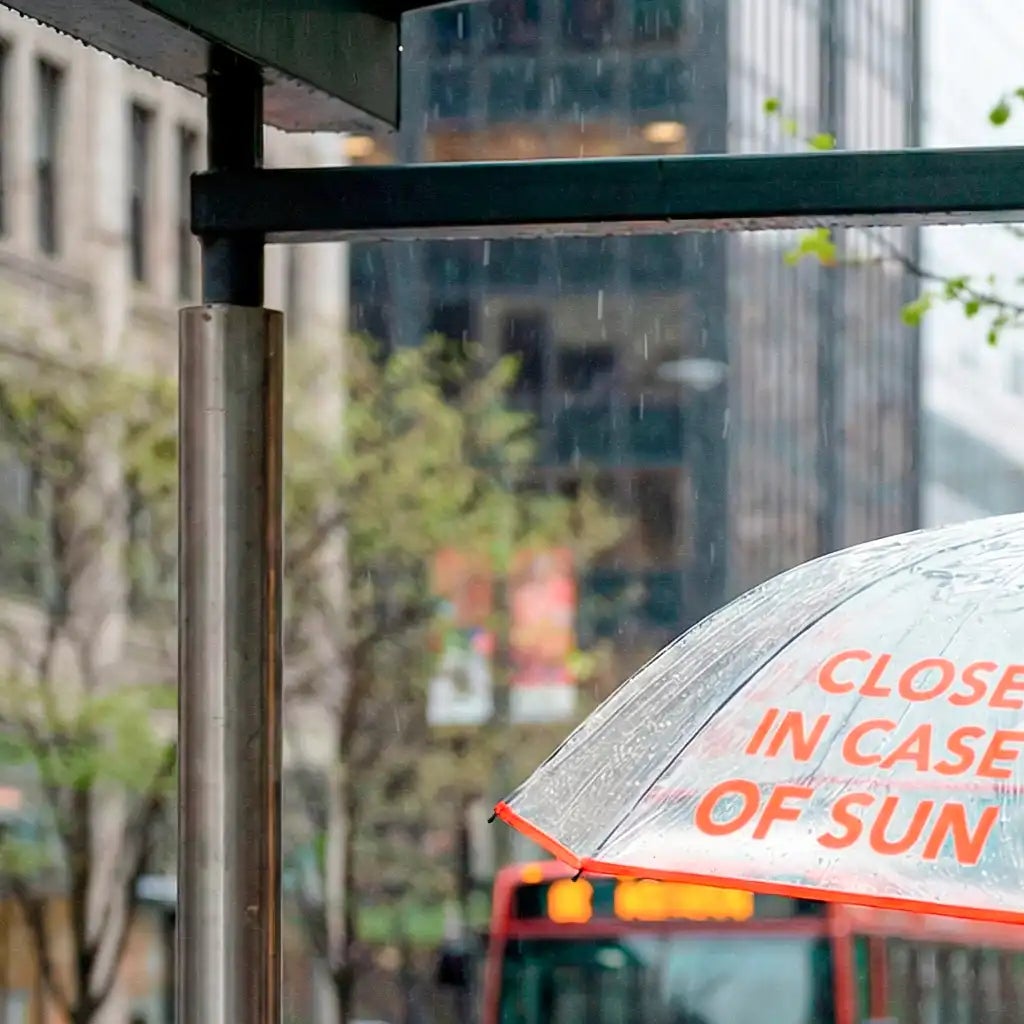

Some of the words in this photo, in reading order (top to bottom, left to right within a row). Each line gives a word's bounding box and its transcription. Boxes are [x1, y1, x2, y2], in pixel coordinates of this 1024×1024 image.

[746, 708, 831, 762] IN
[695, 778, 814, 840] OF
[817, 792, 1000, 865] SUN
